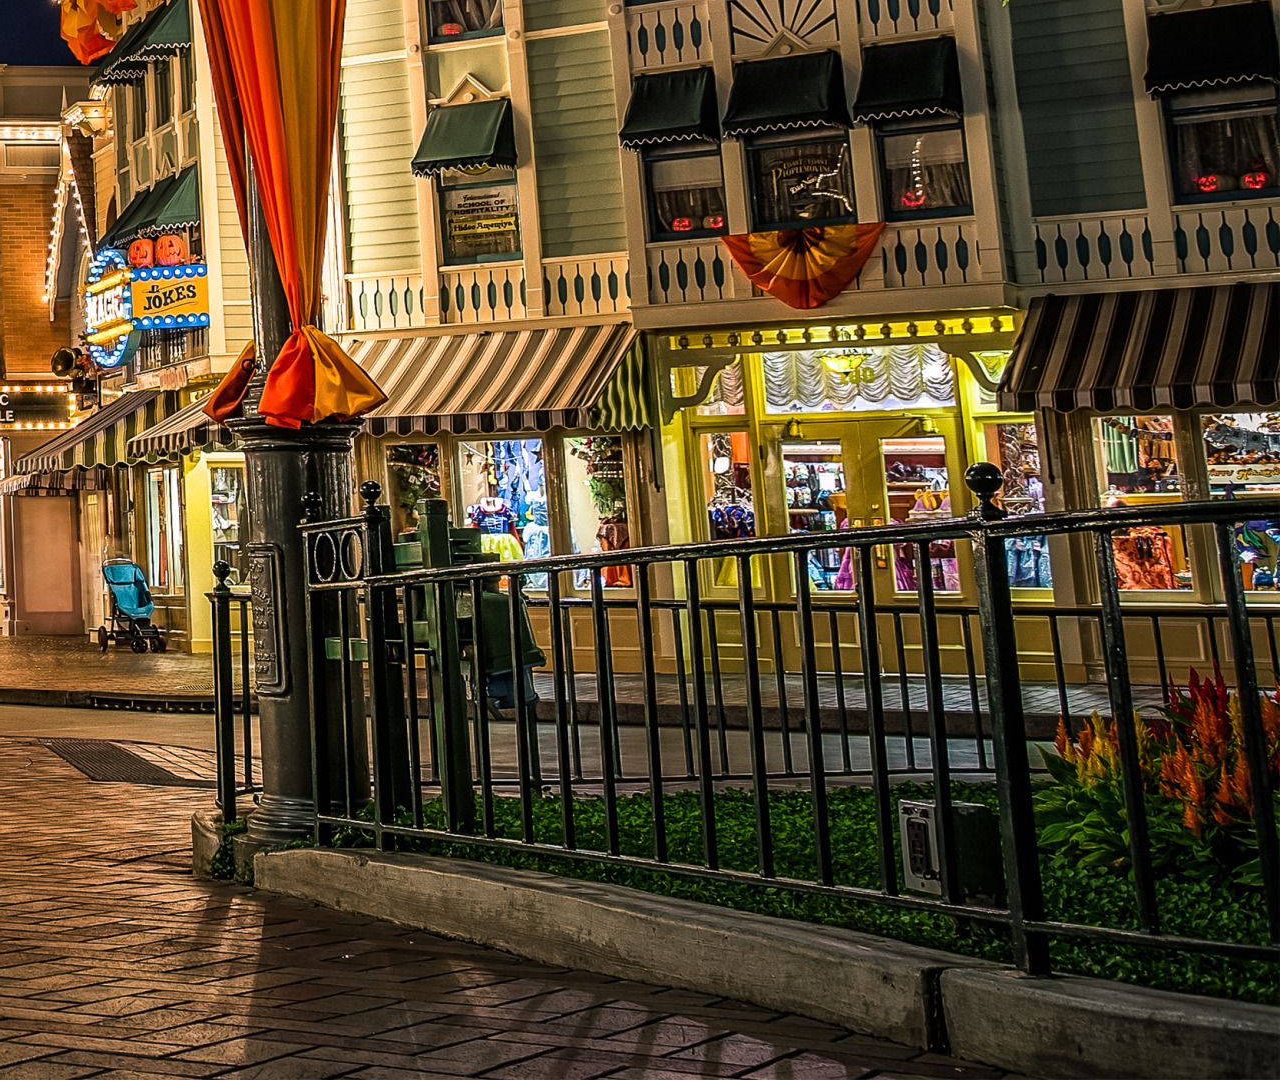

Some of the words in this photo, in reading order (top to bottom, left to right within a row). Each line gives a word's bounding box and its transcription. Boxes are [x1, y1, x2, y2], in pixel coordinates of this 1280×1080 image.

[454, 205, 510, 216] HOSPITALITY
[457, 201, 492, 209] SCHOOL
[143, 284, 197, 311] JOKES
